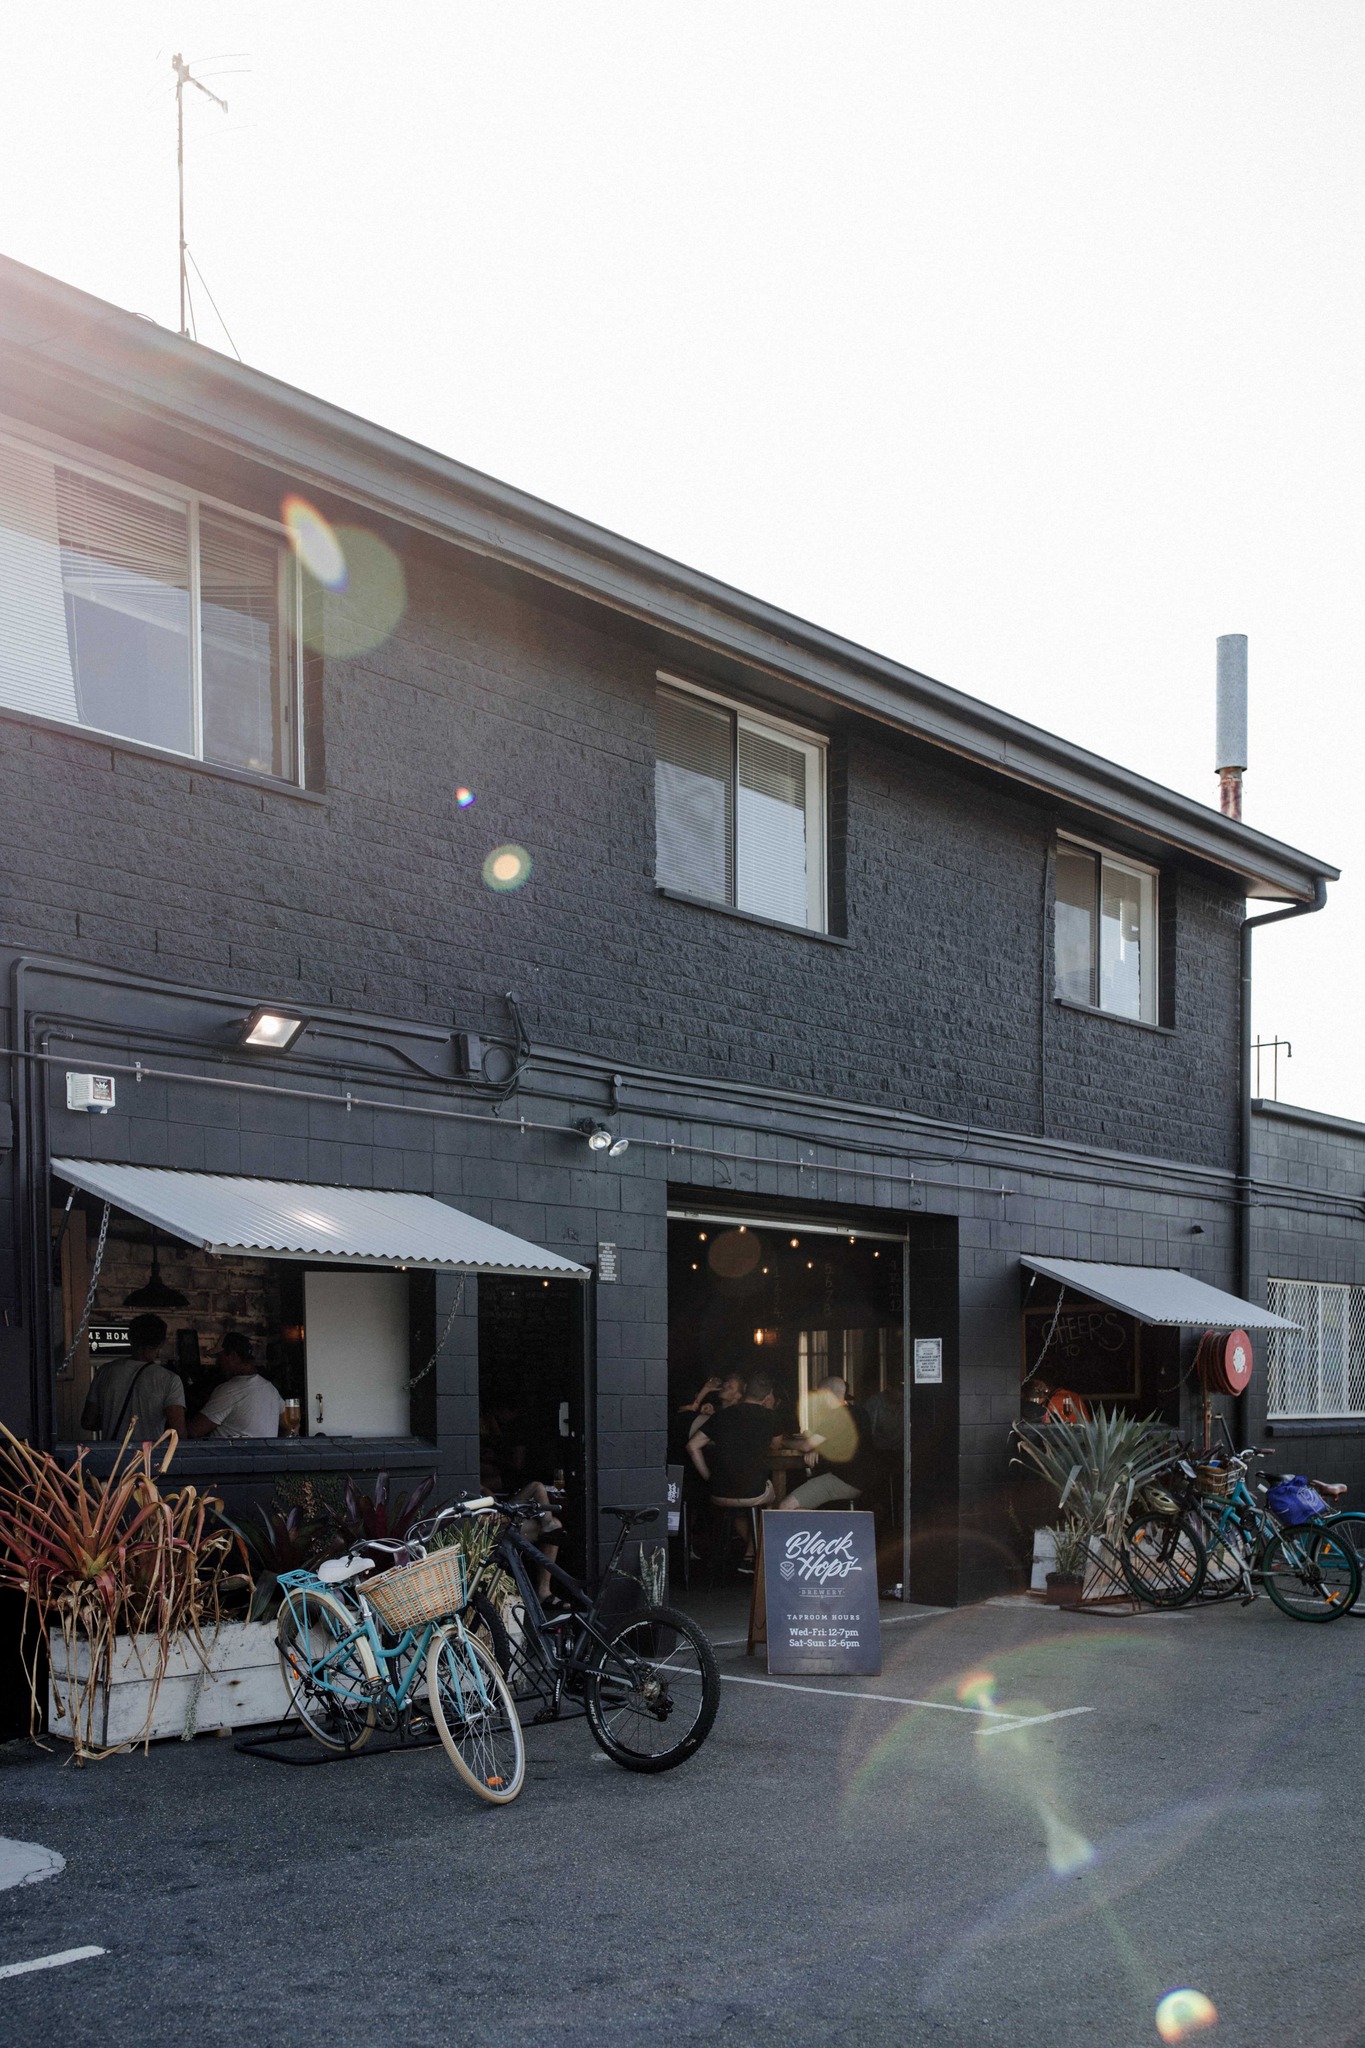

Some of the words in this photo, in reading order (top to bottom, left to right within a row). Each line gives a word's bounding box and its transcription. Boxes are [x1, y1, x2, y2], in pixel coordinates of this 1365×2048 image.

[1041, 1312, 1127, 1352] CHEERS
[1062, 1344, 1080, 1357] TO
[785, 1530, 854, 1560] Black
[796, 1553, 863, 1585] Hops
[789, 1628, 828, 1637] Wed-Fri:
[828, 1628, 859, 1638] 12-7pm
[789, 1639, 827, 1647] Sat-Sun:
[828, 1639, 860, 1649] 12-6pm
